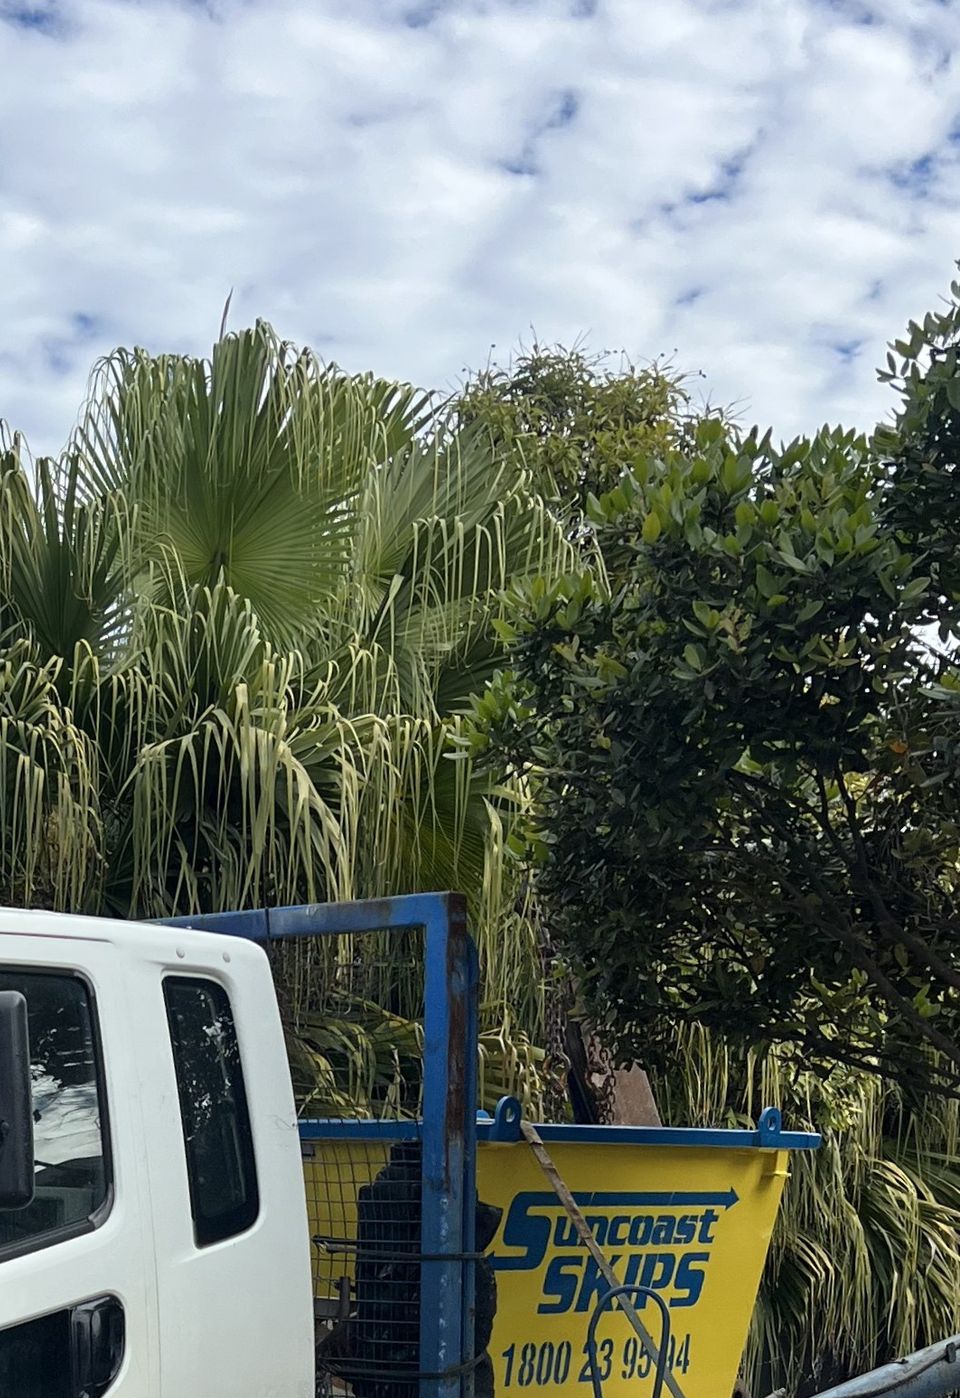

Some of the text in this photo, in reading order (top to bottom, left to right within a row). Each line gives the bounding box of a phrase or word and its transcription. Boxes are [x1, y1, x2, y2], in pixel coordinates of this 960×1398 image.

[487, 1187, 740, 1271] Suncoast
[537, 1252, 711, 1314] SKIPS
[502, 1341, 573, 1387] 1800
[578, 1337, 614, 1382] 23
[622, 1335, 653, 1379] 95
